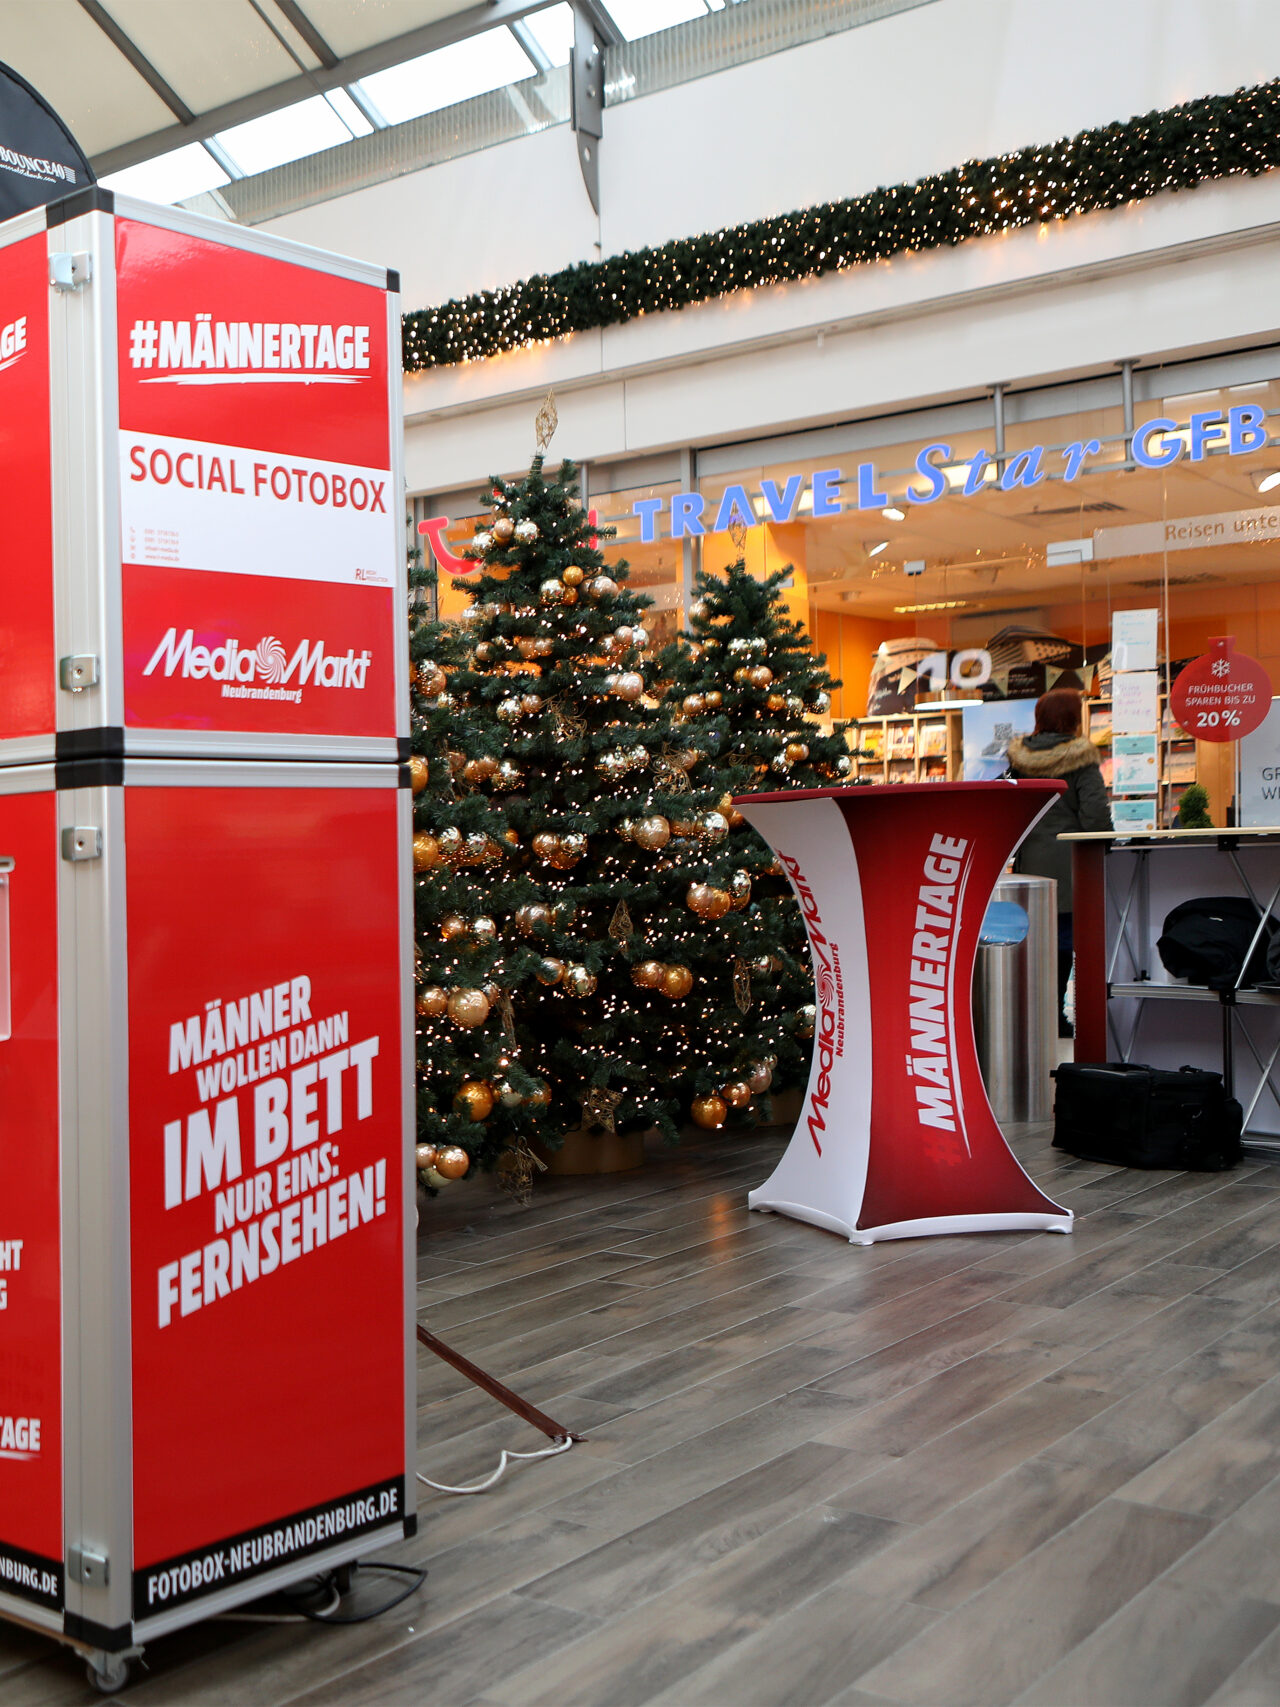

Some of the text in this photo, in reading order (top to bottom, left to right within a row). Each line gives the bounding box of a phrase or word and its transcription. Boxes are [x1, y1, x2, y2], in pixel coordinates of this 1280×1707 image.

[129, 313, 370, 370] #MÄNNERTAGE
[129, 444, 387, 514] SOCIAL FOTOBOX
[632, 462, 888, 544] TRAVEL
[906, 438, 1101, 505] Star
[1130, 403, 1268, 469] GFB
[1164, 514, 1280, 542] Reisen unte
[141, 627, 371, 689] Media Markt
[221, 683, 303, 704] Neubrandenburg
[1185, 693, 1256, 707] SPAREN BIS ZU
[1187, 682, 1254, 694] FRÜHBUCHER
[169, 974, 312, 1075] MÄNNER
[830, 942, 845, 1058] Neubrandenburg
[196, 1010, 349, 1103] WOLLEN DANN
[807, 1003, 836, 1159] Media
[164, 1035, 380, 1211] IM BETT
[215, 1142, 339, 1234] NUR EINS:
[157, 1157, 387, 1330] FERNSEHEN!
[147, 1487, 398, 1605] FOTOBOX-NEUBRANDENBURG.DE
